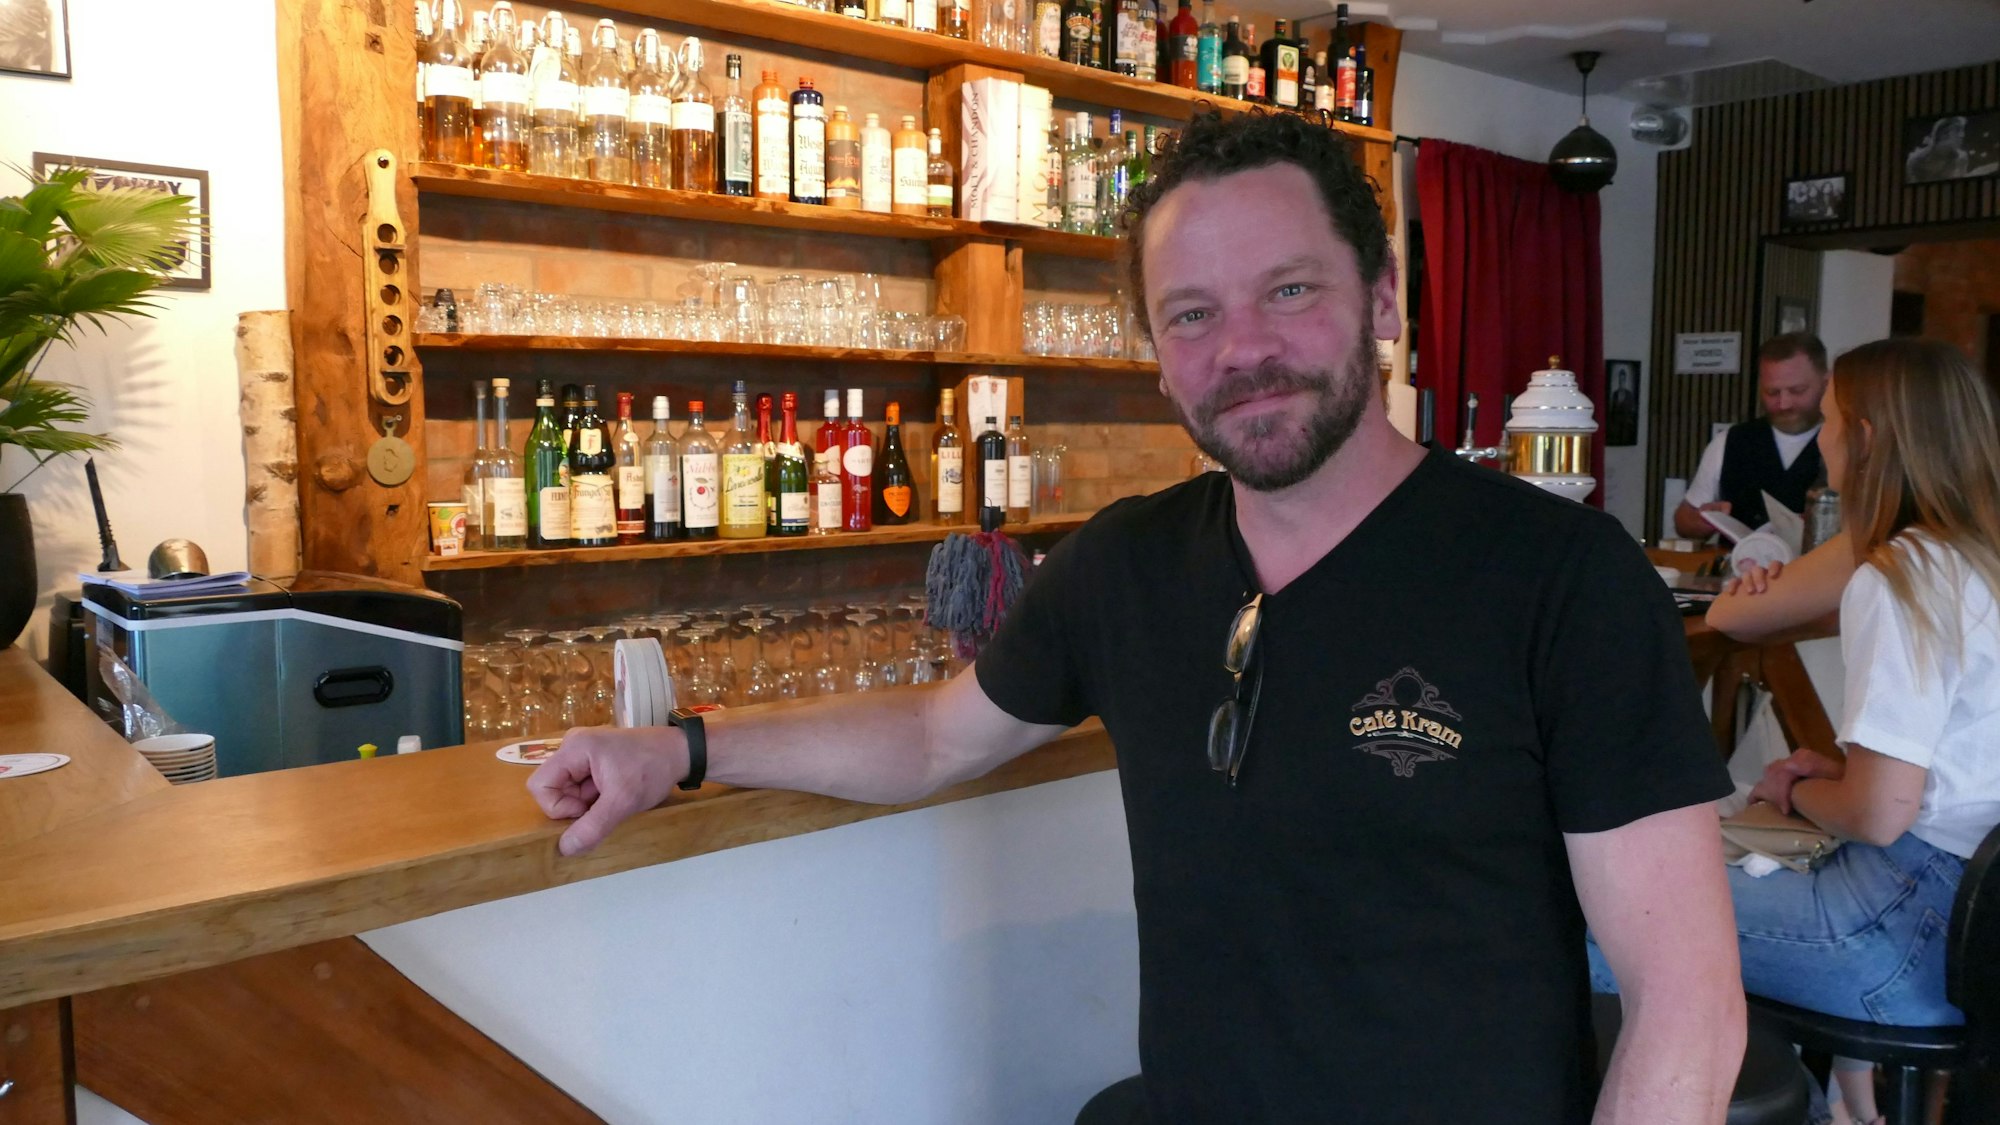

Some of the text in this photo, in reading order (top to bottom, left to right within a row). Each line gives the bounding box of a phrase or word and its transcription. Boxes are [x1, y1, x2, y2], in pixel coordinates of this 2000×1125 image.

[970, 92, 979, 157] CHANDON
[1349, 708, 1463, 749] Café Kram
